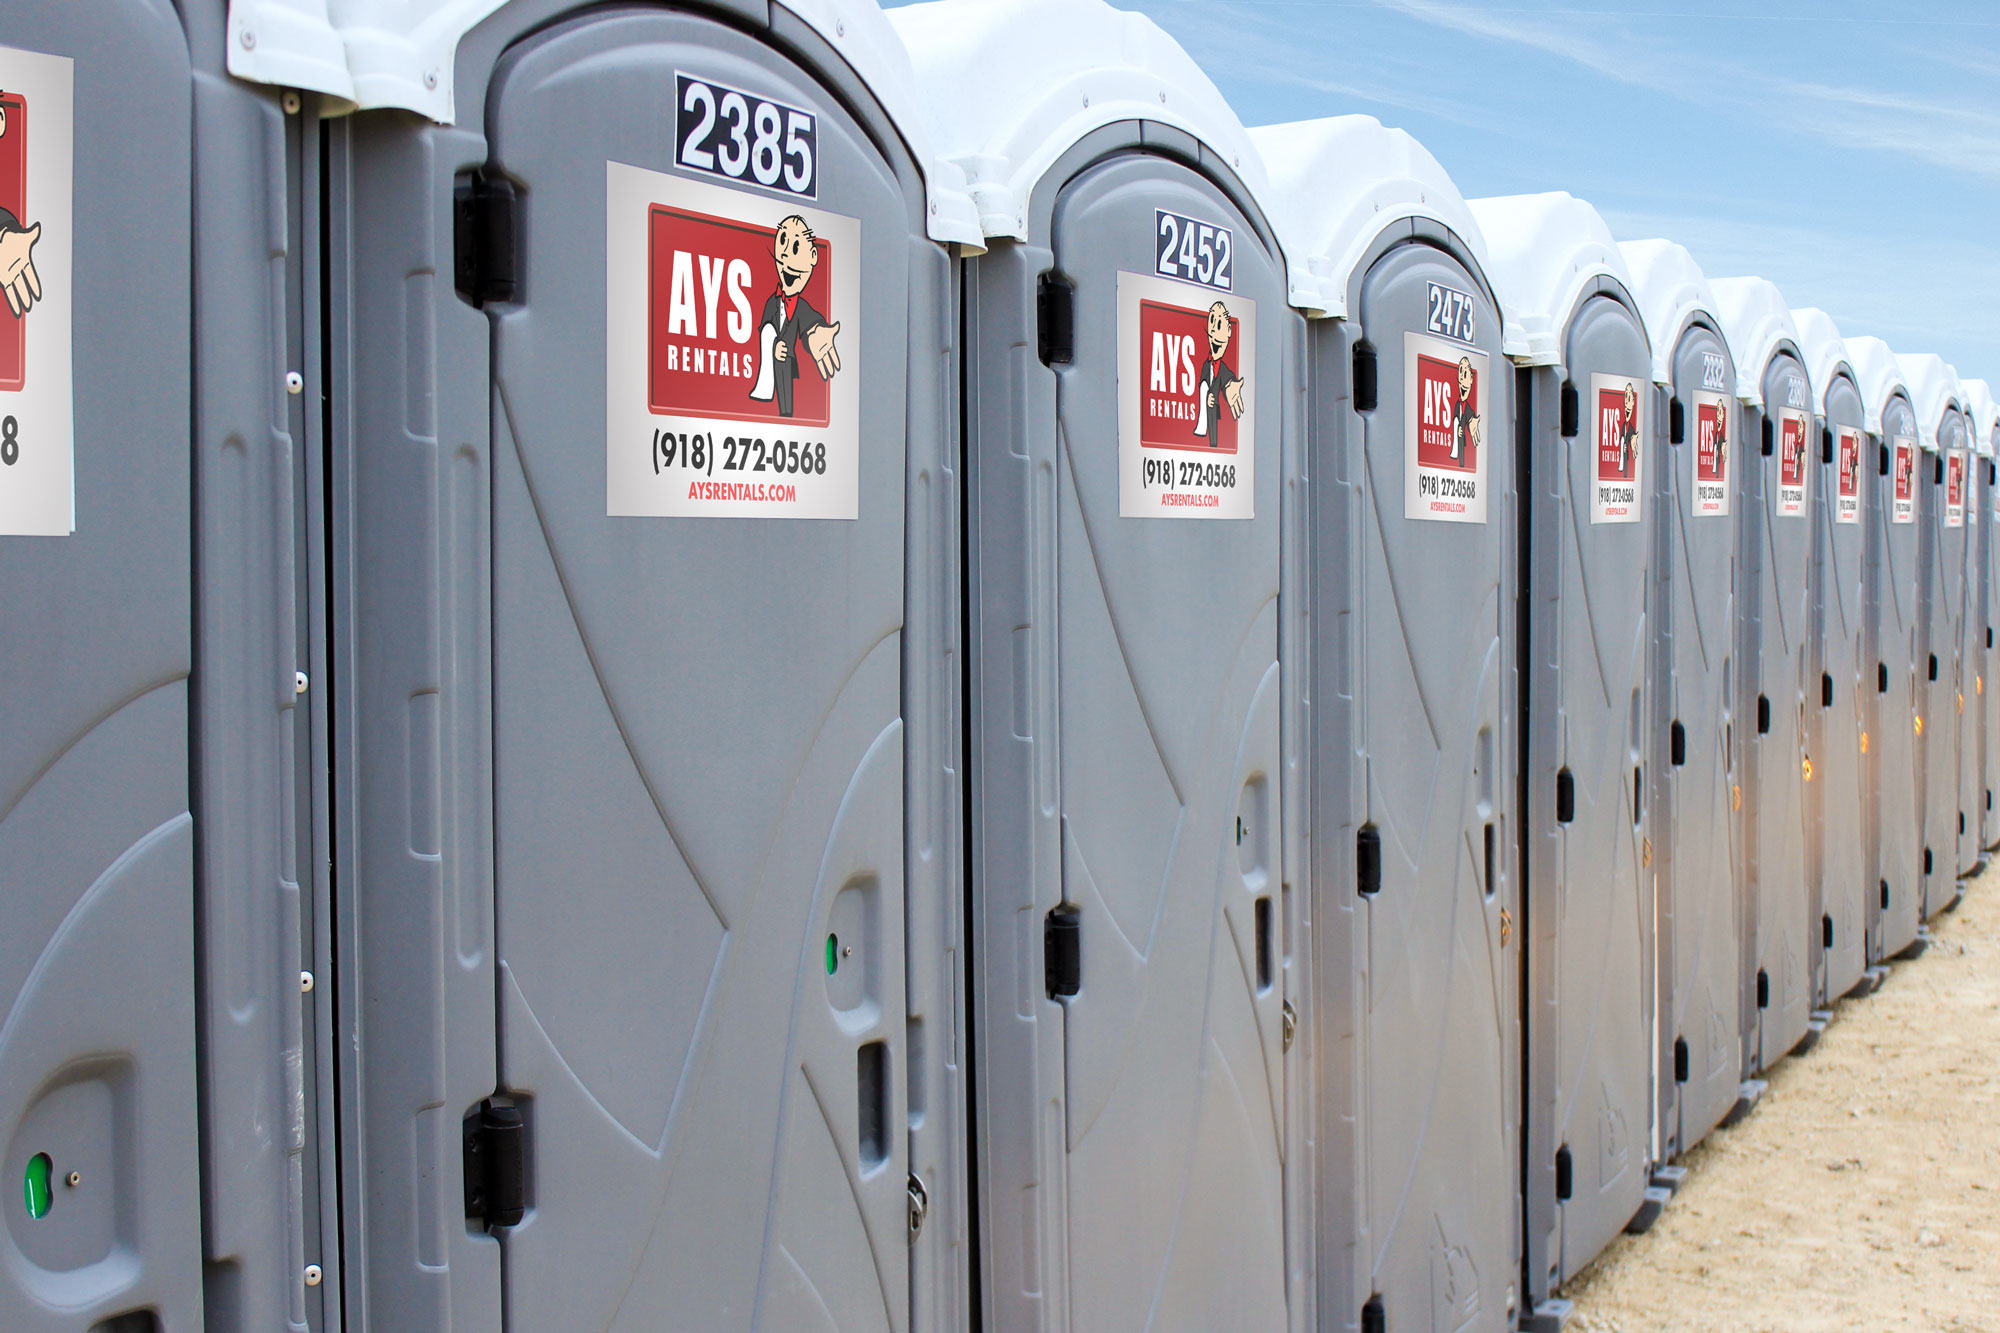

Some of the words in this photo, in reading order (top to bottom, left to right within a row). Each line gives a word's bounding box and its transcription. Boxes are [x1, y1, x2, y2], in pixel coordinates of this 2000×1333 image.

[681, 81, 813, 193] 2385
[1158, 214, 1231, 289] 2452
[667, 249, 753, 345] AYS
[1428, 285, 1474, 342] 2473
[667, 344, 753, 380] RENTALS
[1150, 331, 1196, 397] AYS
[1150, 398, 1196, 421] RENTALS
[1423, 378, 1452, 429] AYS
[1423, 429, 1452, 447] RENTALS
[1602, 407, 1620, 447] AYS
[1700, 419, 1714, 453] AYS
[652, 428, 714, 477] (918)
[722, 437, 827, 476] 272-0568
[688, 481, 797, 503] AYSRENTALS.COM
[1142, 457, 1175, 491] (918)
[1179, 462, 1236, 488] 272-0568
[1418, 473, 1439, 500] (918)
[1441, 477, 1476, 499] 272-0568
[1161, 493, 1219, 508] AYSRENTALS.COM
